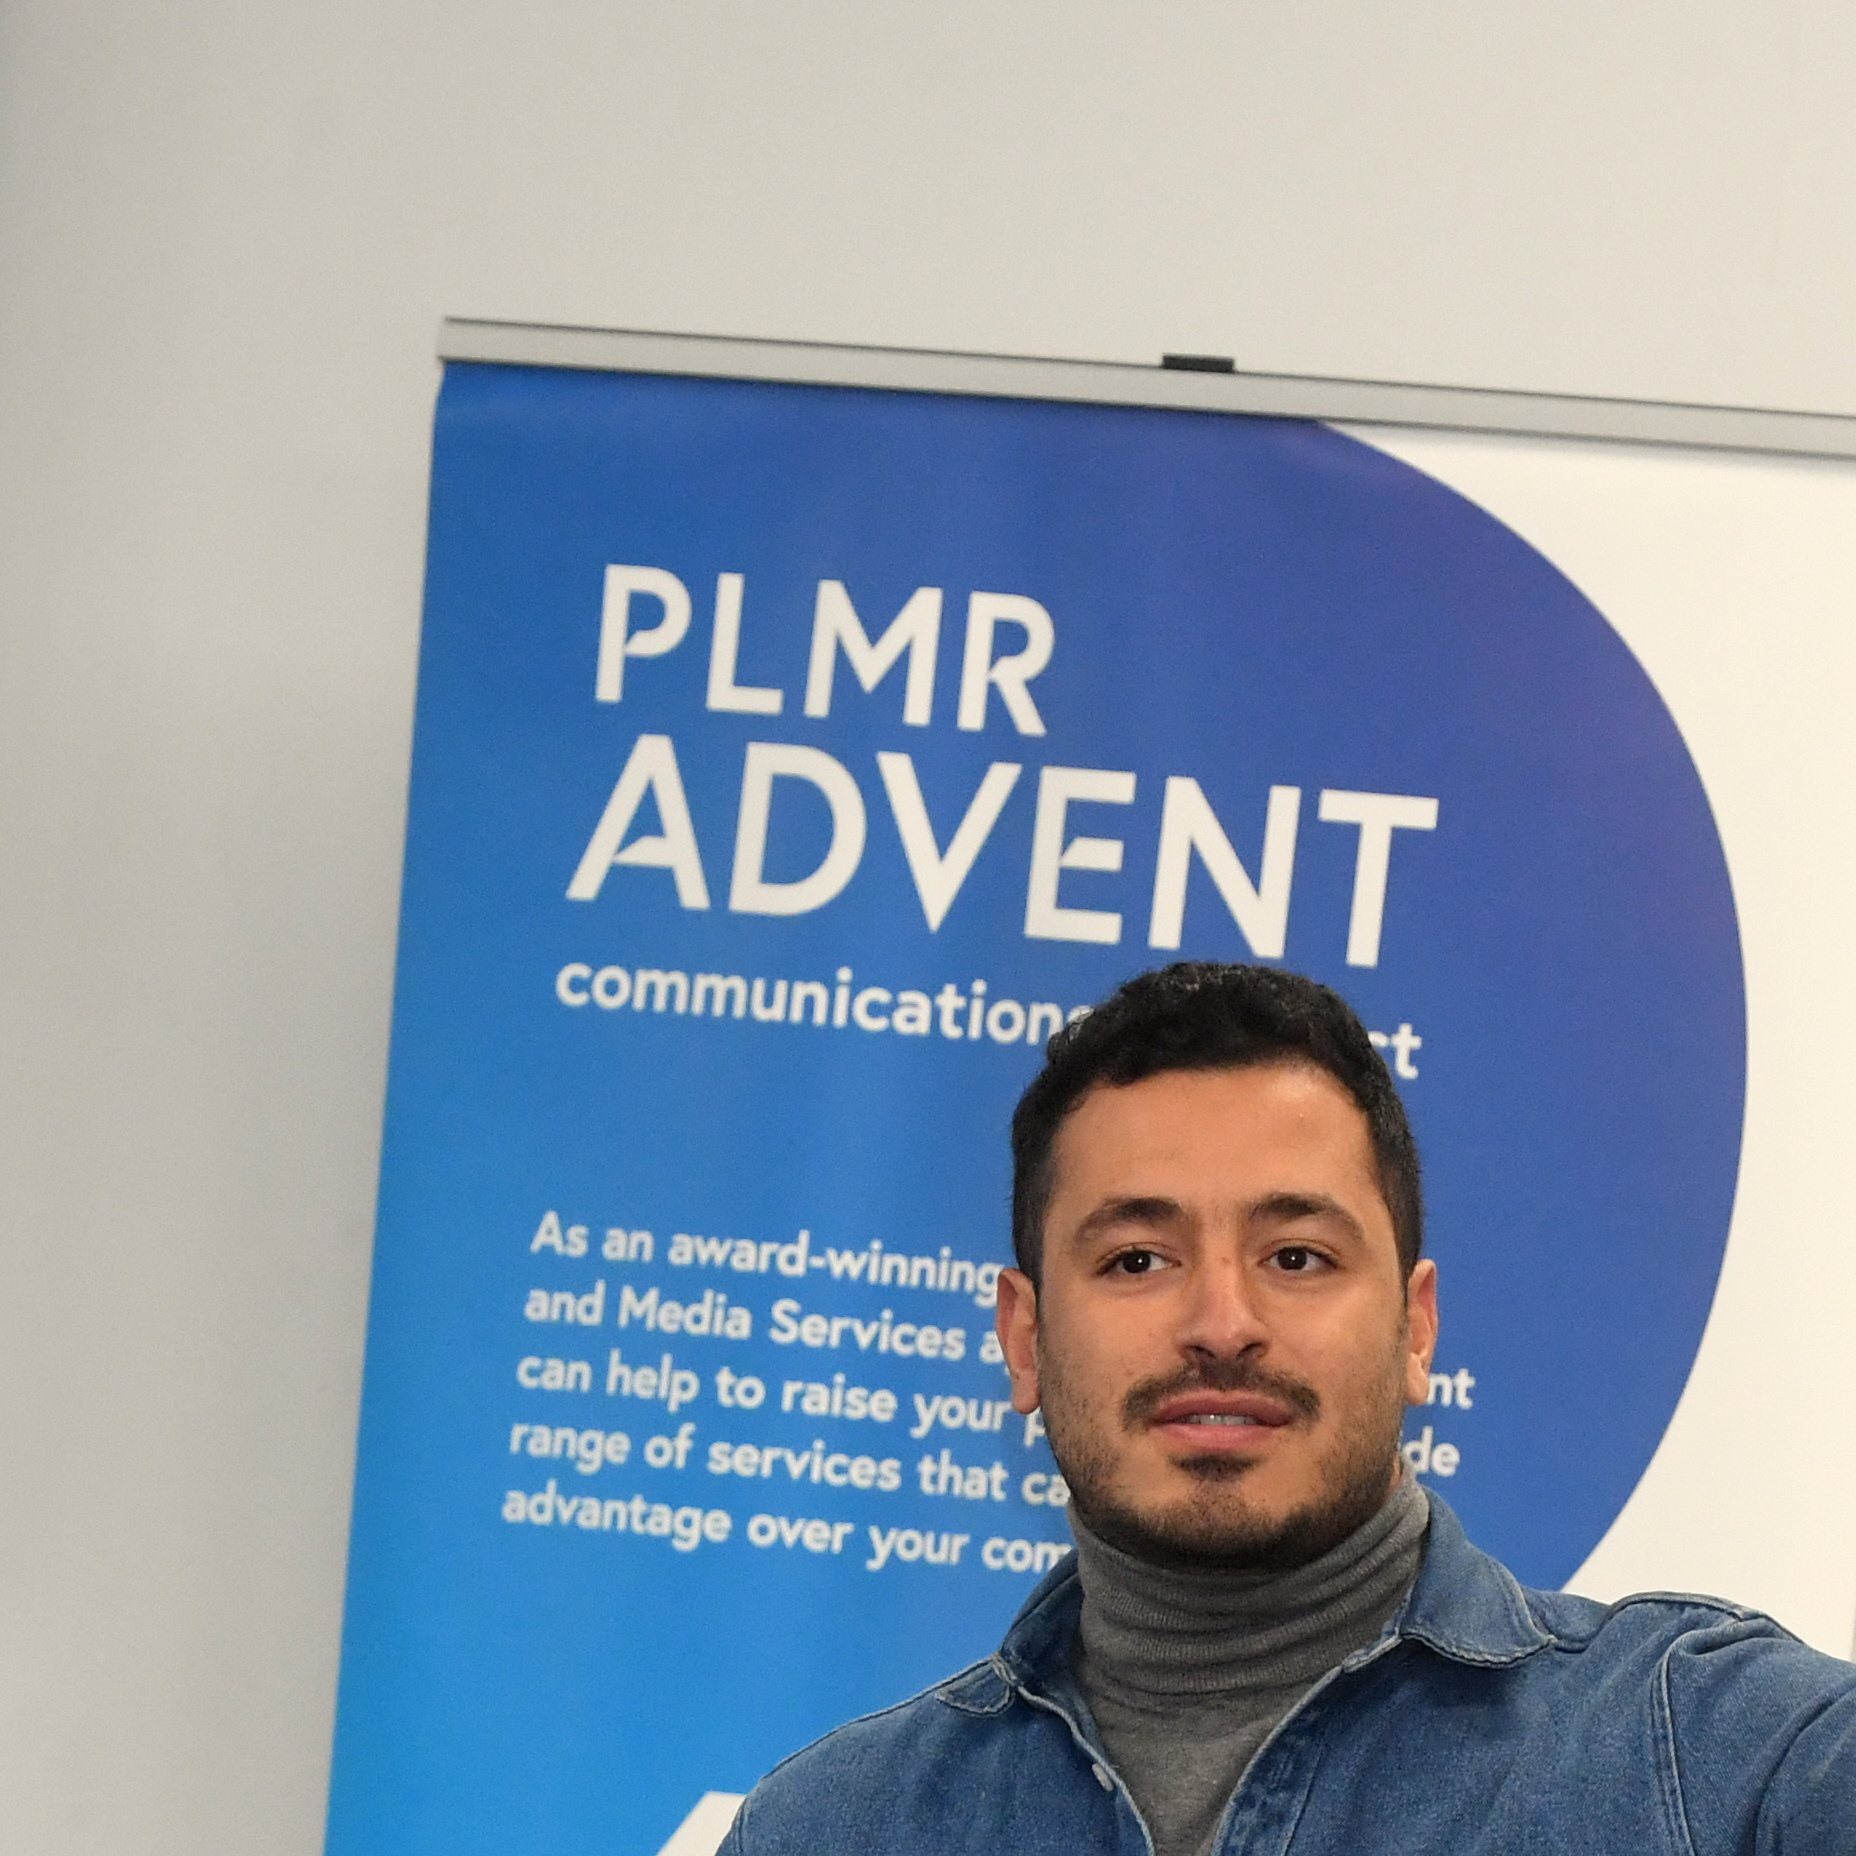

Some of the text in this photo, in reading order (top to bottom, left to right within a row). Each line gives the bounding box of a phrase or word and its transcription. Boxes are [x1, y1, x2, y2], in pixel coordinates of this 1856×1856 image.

[594, 563, 1056, 737] PLMR
[565, 733, 1439, 968] ADVENT
[530, 1210, 1003, 1307] As an award-winning
[524, 1279, 606, 1326] and
[618, 1285, 752, 1342] Media
[769, 1298, 967, 1362] Services
[516, 1352, 591, 1393] can
[606, 1348, 700, 1413] help
[715, 1366, 765, 1410] to
[781, 1373, 898, 1424] raise
[913, 1394, 1011, 1439] your
[509, 1421, 631, 1474] range
[645, 1422, 696, 1469] of
[707, 1440, 902, 1491] services
[917, 1450, 1008, 1501] that
[501, 1479, 732, 1552] advantage
[746, 1512, 853, 1554] over
[866, 1525, 969, 1571] your
